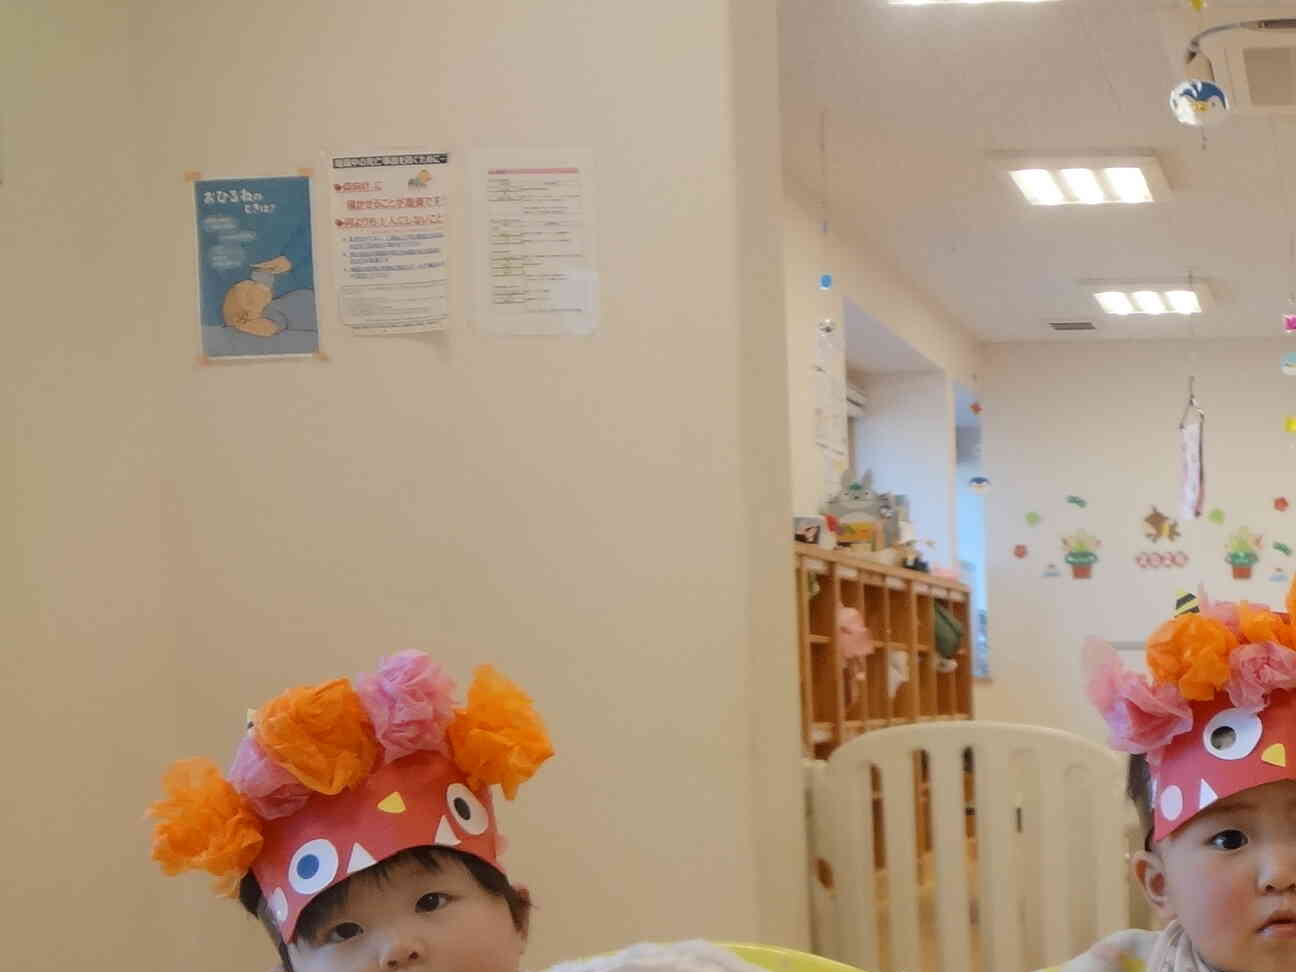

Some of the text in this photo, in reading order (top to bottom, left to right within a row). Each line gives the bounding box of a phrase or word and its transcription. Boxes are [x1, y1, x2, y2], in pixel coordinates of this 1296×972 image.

[203, 188, 263, 204] おひるねの
